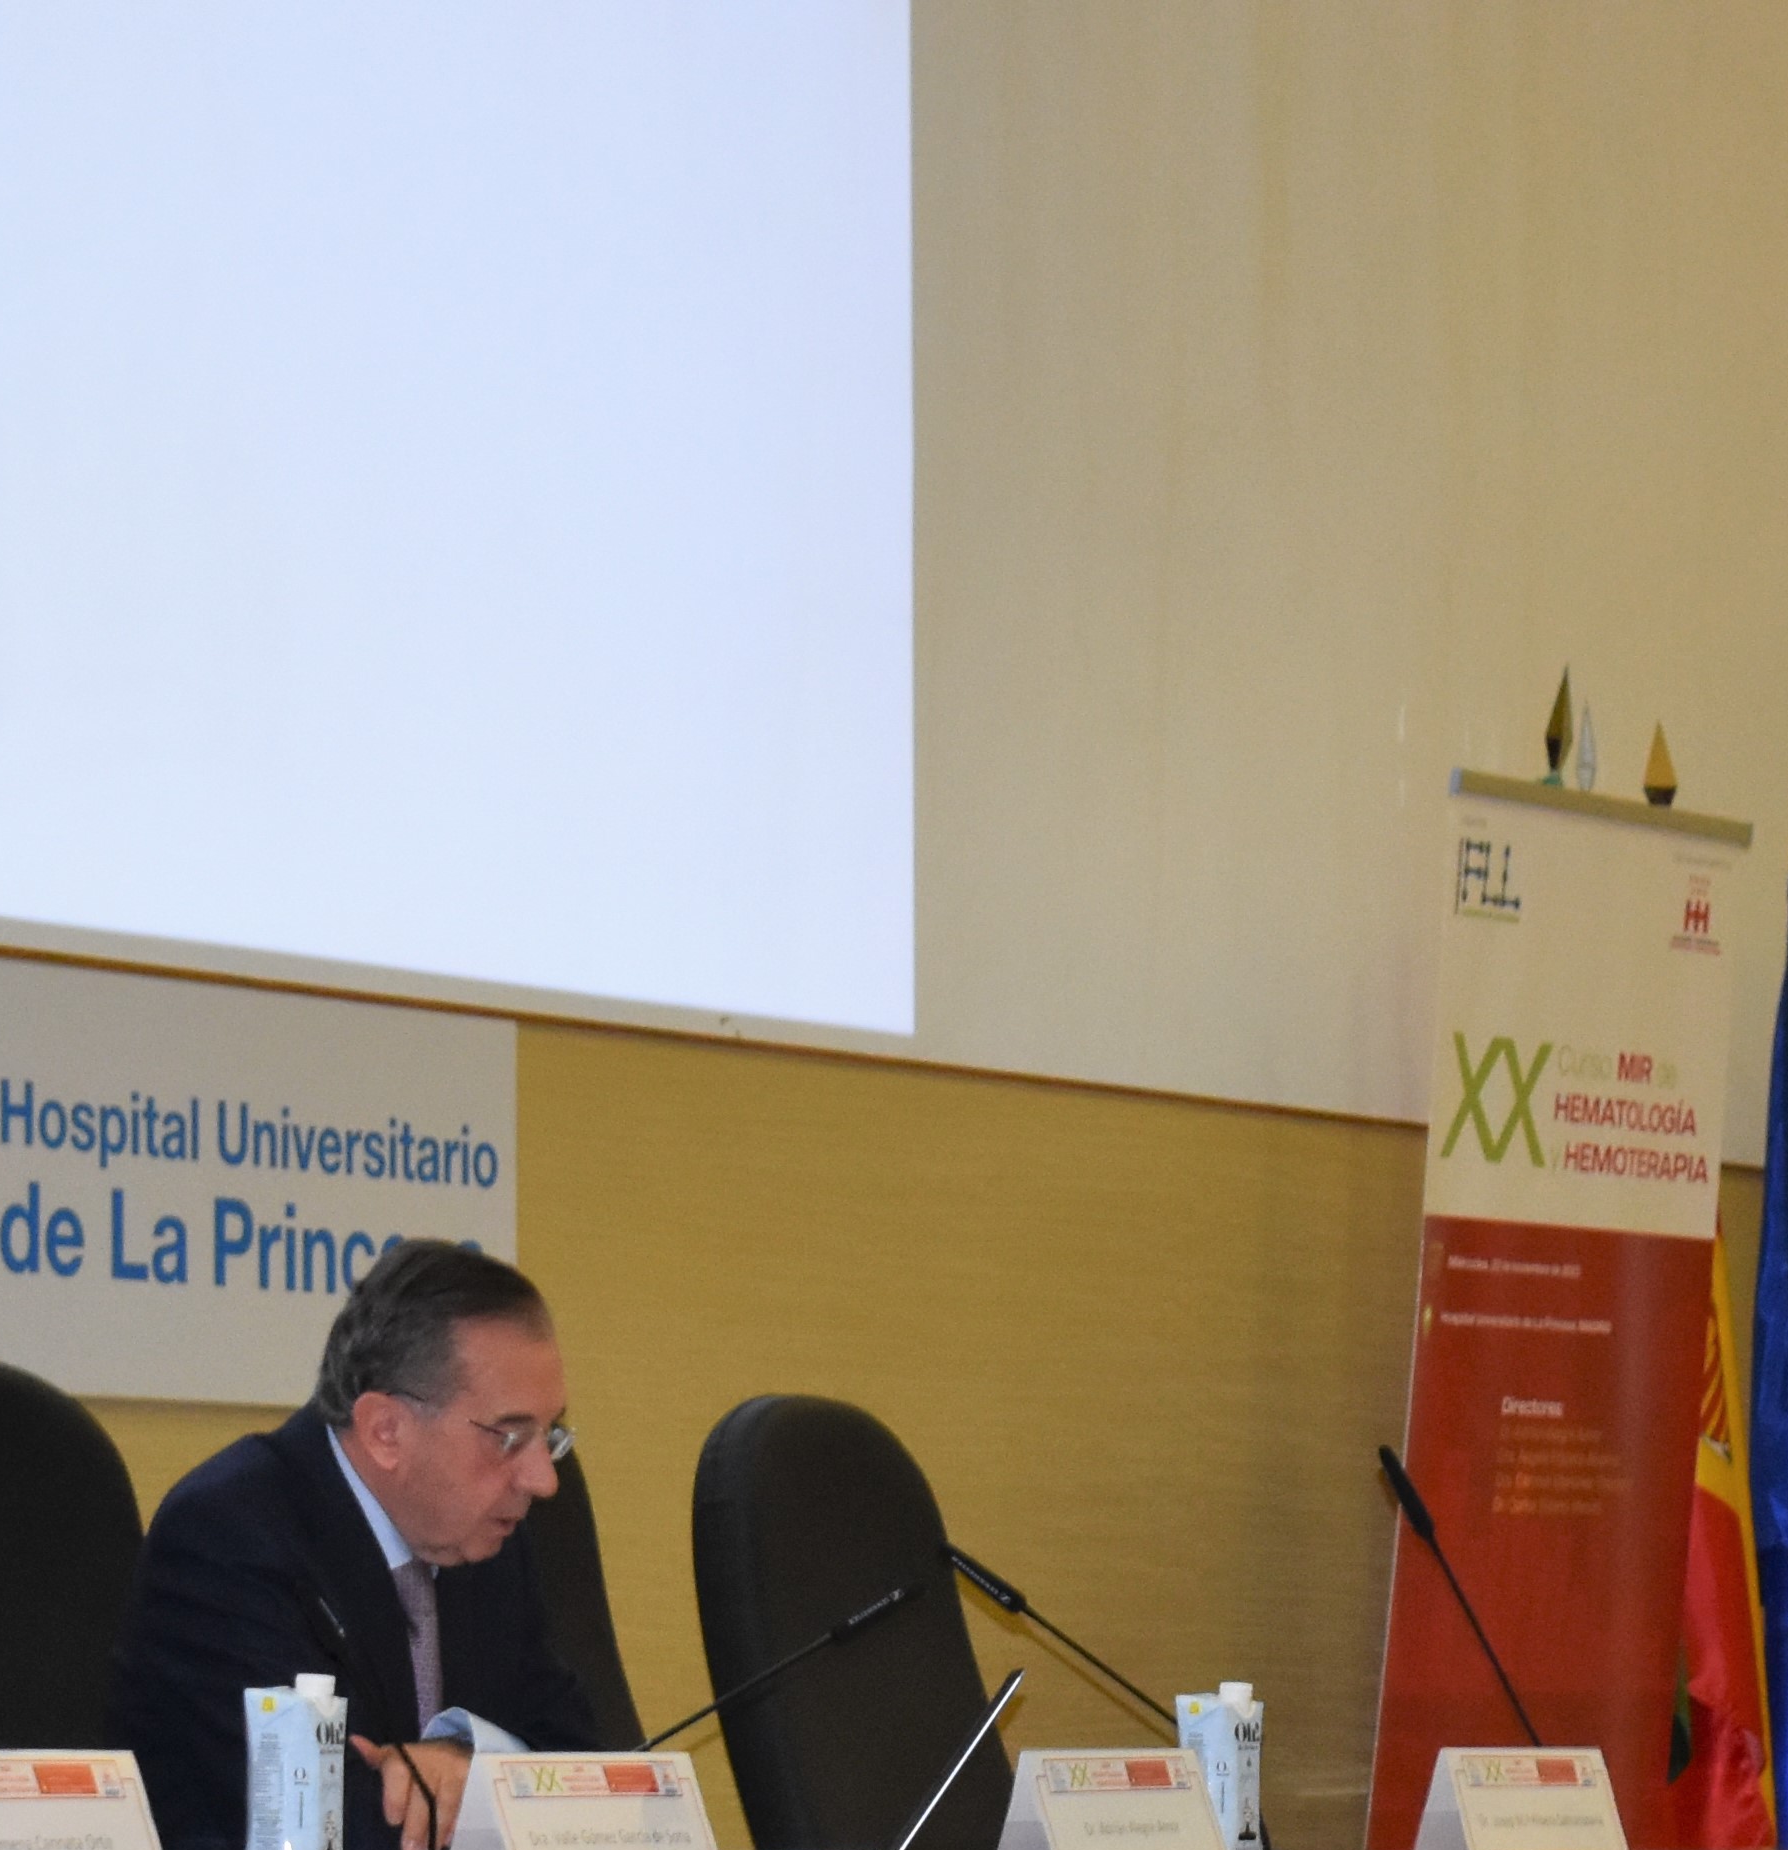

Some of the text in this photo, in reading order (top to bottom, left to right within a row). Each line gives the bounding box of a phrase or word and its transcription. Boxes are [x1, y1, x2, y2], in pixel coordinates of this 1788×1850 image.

[1617, 1052, 1653, 1085] MIR
[0, 1078, 499, 1191] Hospital Universitario
[1554, 1094, 1696, 1137] HEMATOLOGÍA
[1563, 1141, 1708, 1184] HEMOTERAPIA
[0, 1182, 484, 1296] de La Princ
